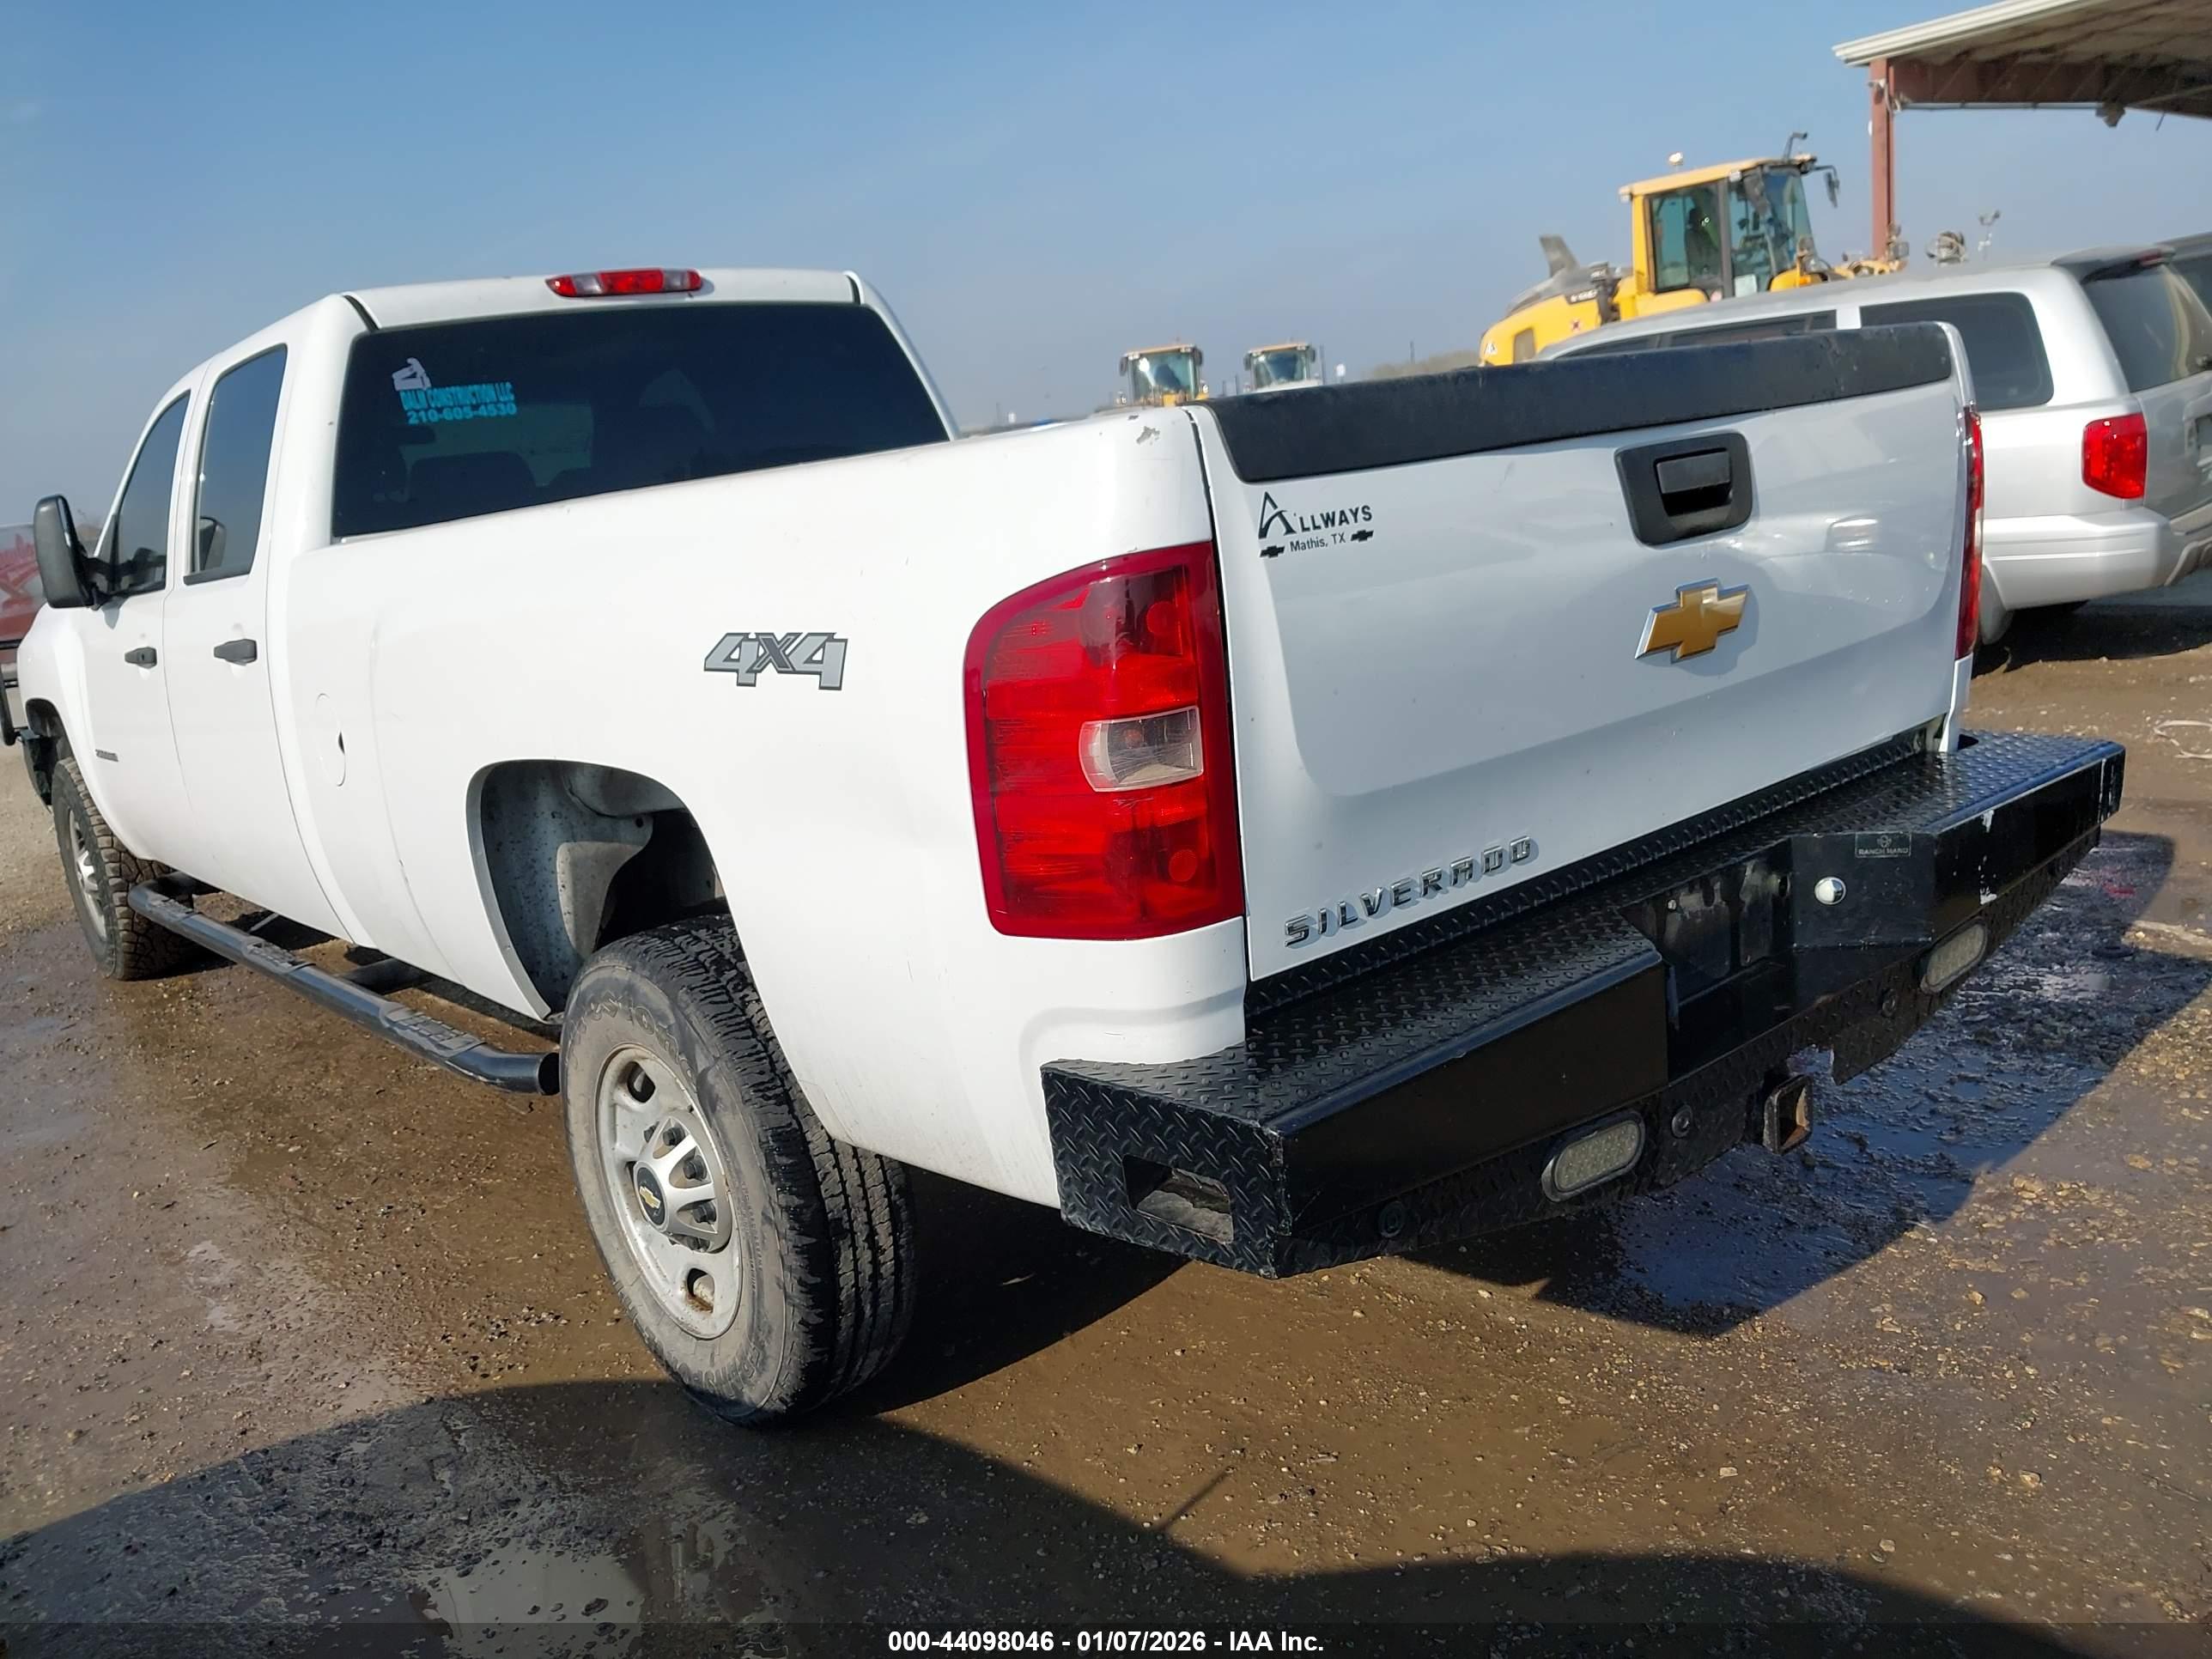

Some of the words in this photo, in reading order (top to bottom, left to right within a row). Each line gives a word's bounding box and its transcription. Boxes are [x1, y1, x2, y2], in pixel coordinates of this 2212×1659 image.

[495, 382, 514, 402] LLC
[407, 402, 518, 425] 210-605-4530
[1258, 491, 1373, 539] ALLWAYS
[1290, 537, 1328, 552] Mathis,
[1331, 532, 1346, 545] TX
[1284, 835, 1532, 948] SILVERADO
